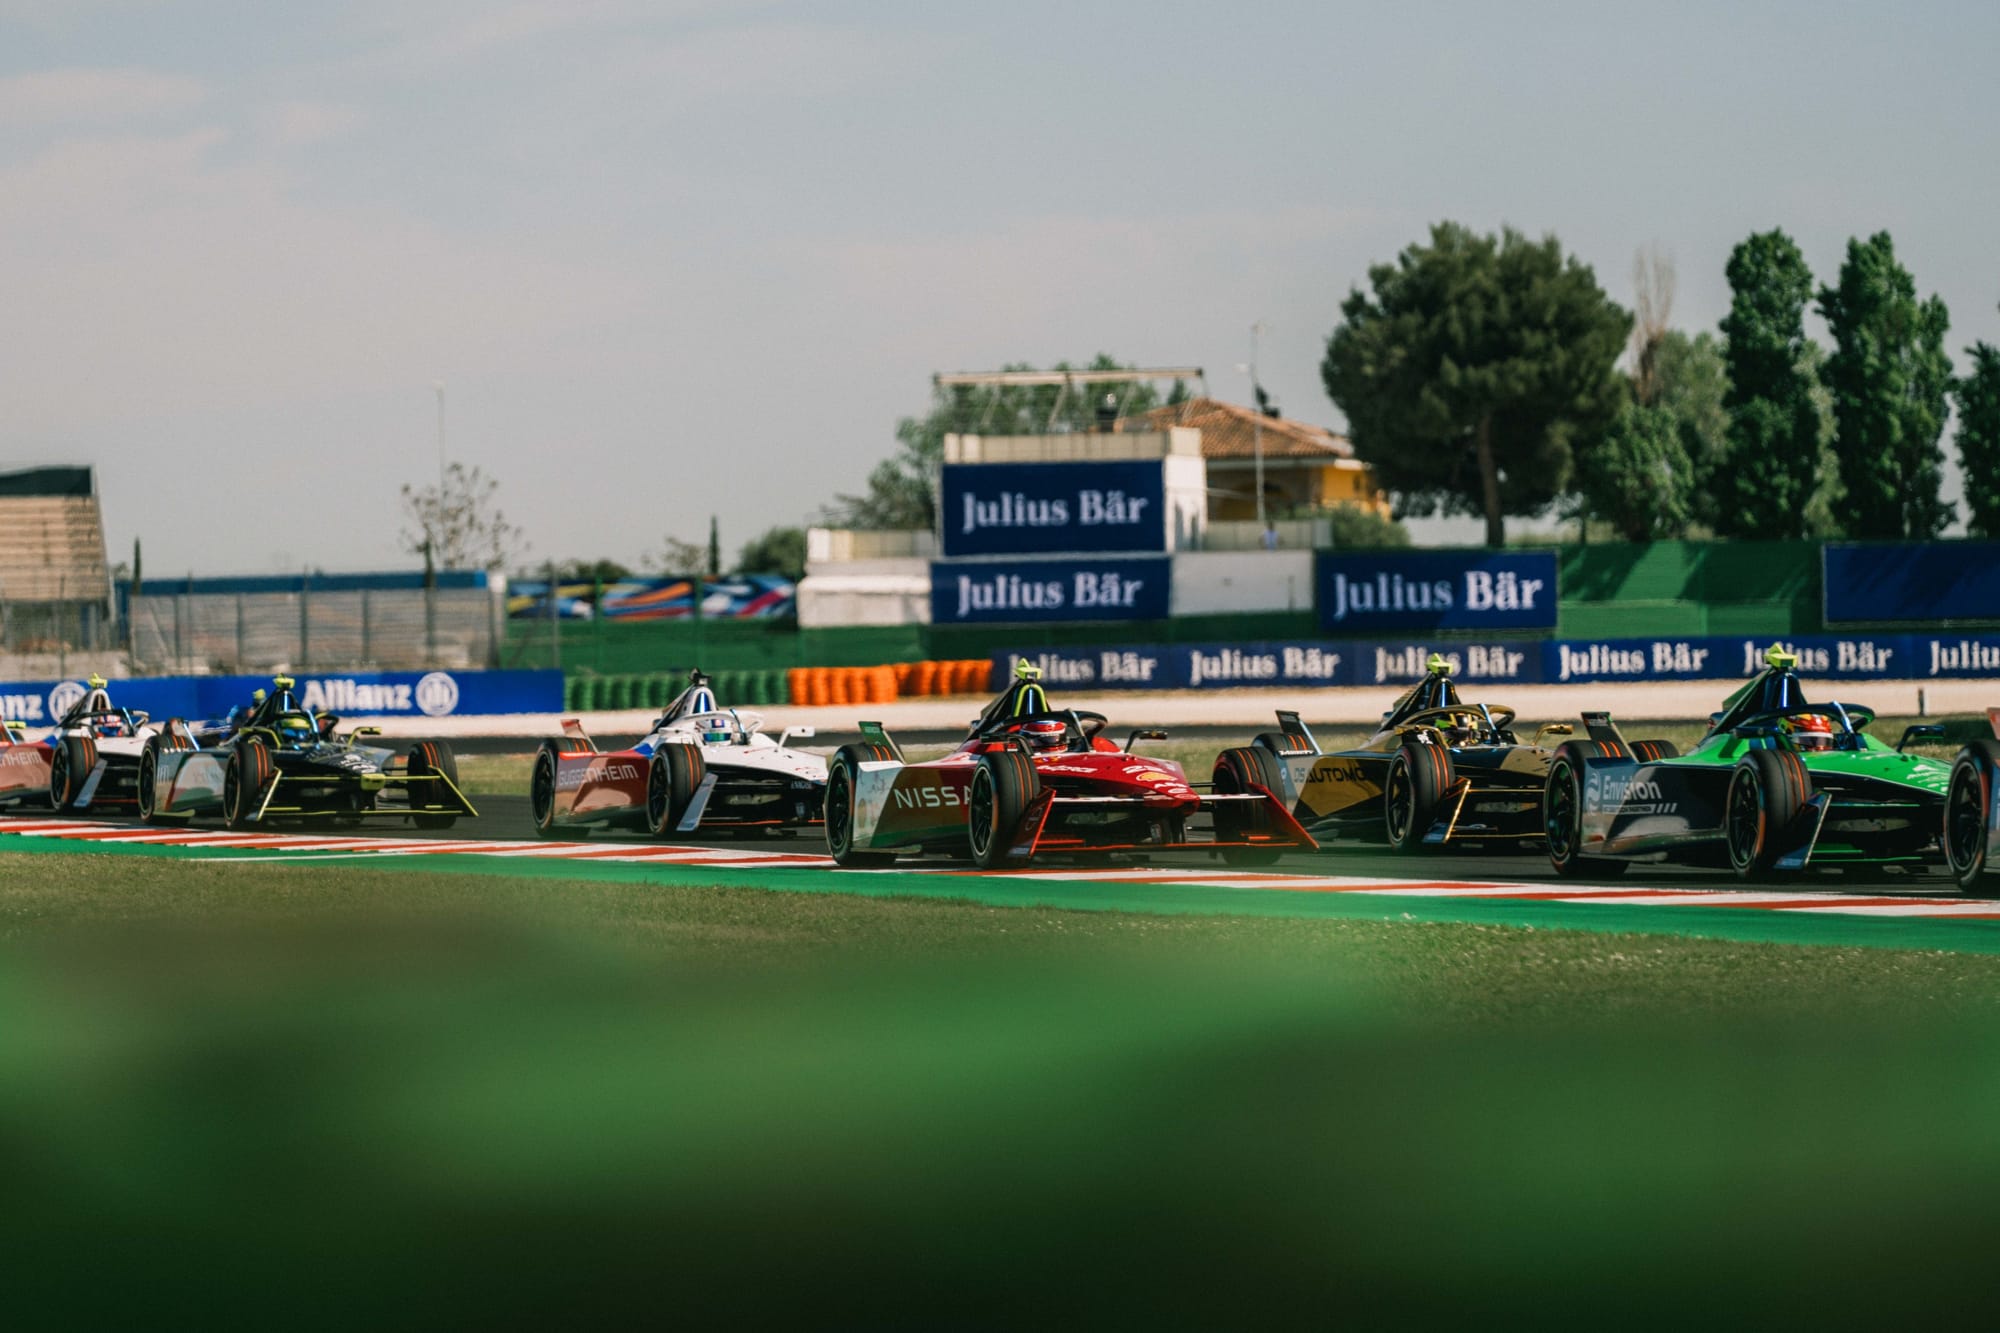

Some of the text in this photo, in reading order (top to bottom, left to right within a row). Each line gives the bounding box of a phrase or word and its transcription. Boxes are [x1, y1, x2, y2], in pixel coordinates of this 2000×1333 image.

[962, 490, 1148, 534] Julius Bär
[957, 571, 1143, 617] Julius Bär
[1334, 570, 1543, 621] Julius Bär
[1101, 651, 1157, 681] Bär
[1190, 647, 1340, 686] Julius Bär
[1468, 646, 1524, 677] Bär
[1559, 642, 1709, 681] Julius Bär
[1836, 640, 1893, 671] Bär
[301, 679, 412, 711] Allianz
[1603, 776, 1662, 801] Envision
